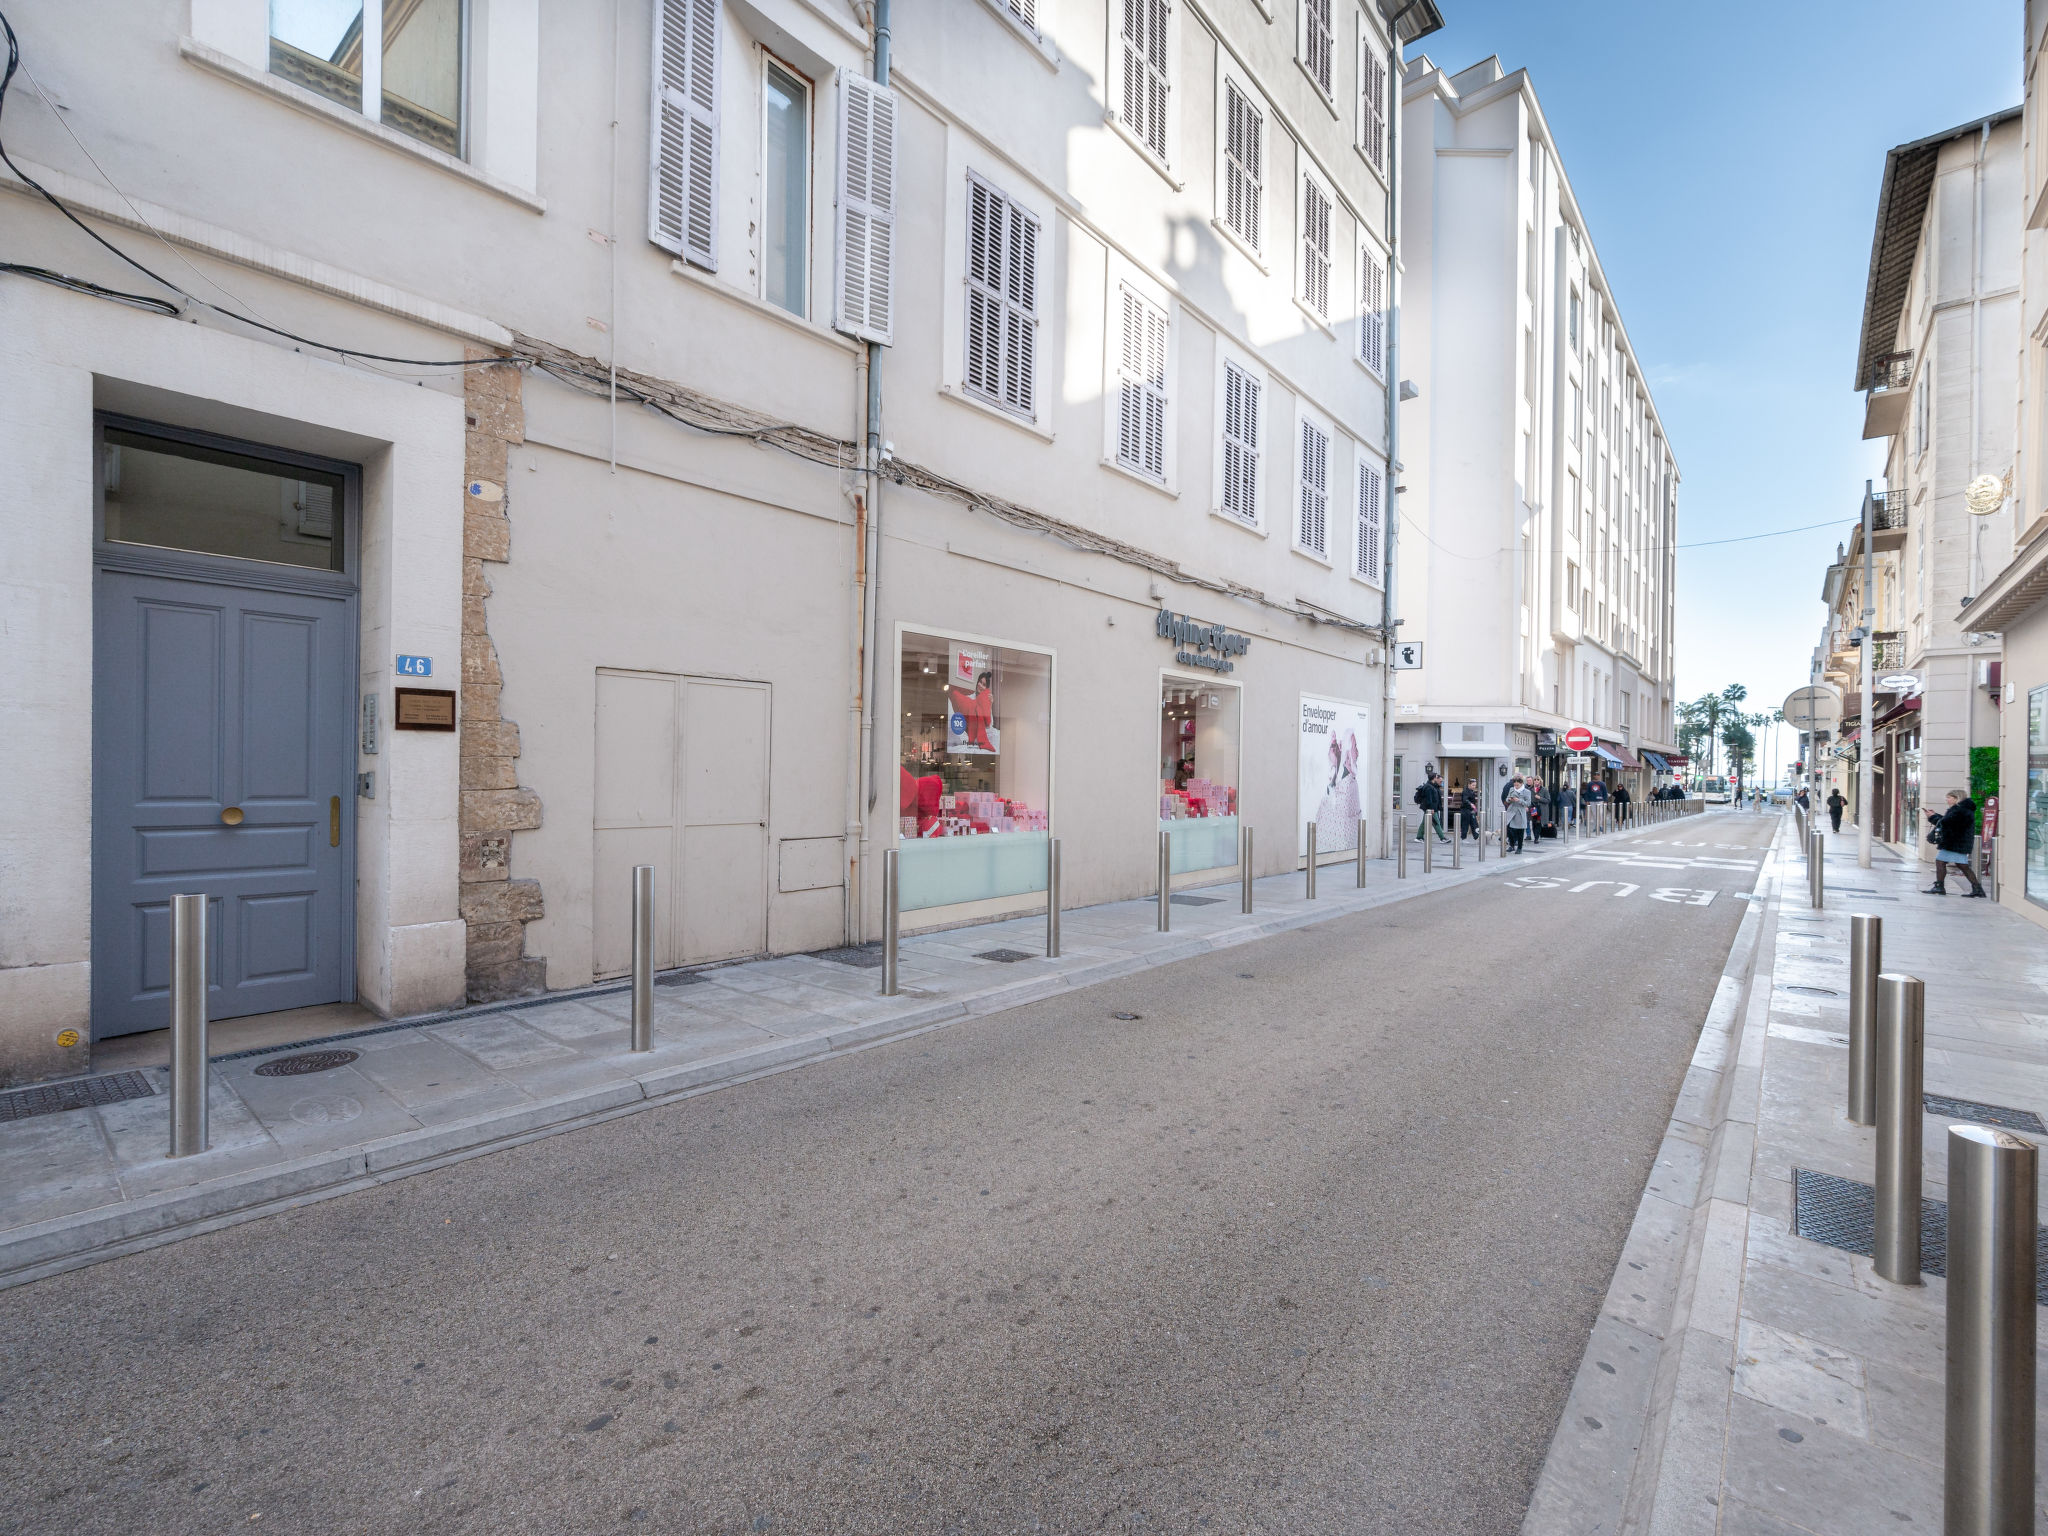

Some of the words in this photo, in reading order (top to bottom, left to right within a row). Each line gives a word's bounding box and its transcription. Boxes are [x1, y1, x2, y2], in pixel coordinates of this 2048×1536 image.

[1157, 609, 1209, 652] flying
[1210, 624, 1251, 658] tiger
[404, 657, 425, 674] 46
[964, 659, 986, 669] parfait
[1176, 651, 1234, 672] copenhagen
[1302, 703, 1337, 724] Envelopper
[1302, 719, 1329, 734] d'amour
[1504, 875, 1722, 908] BUS
